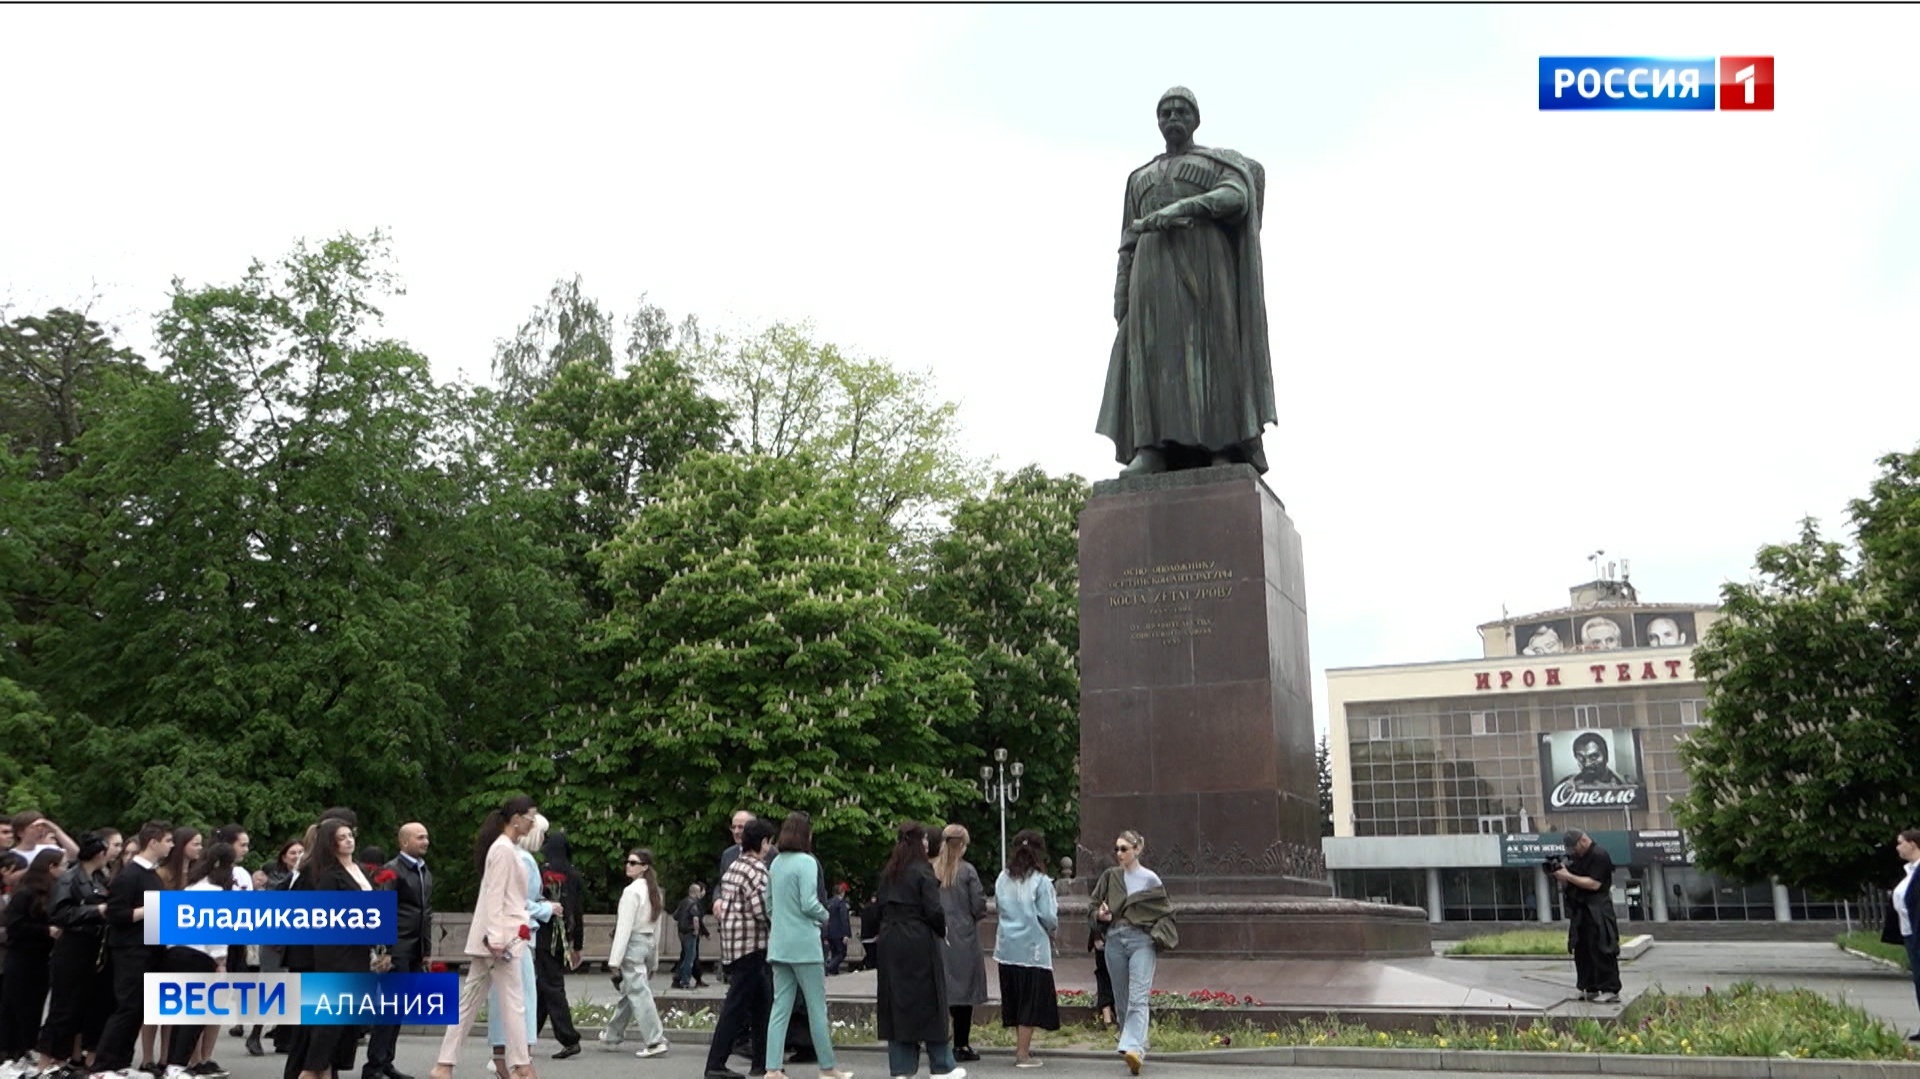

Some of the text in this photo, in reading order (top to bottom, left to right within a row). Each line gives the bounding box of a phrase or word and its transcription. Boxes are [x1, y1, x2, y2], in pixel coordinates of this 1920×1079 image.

[1474, 660, 1681, 690] ИРОН ТЕАТ
[1551, 782, 1636, 808] Отелло
